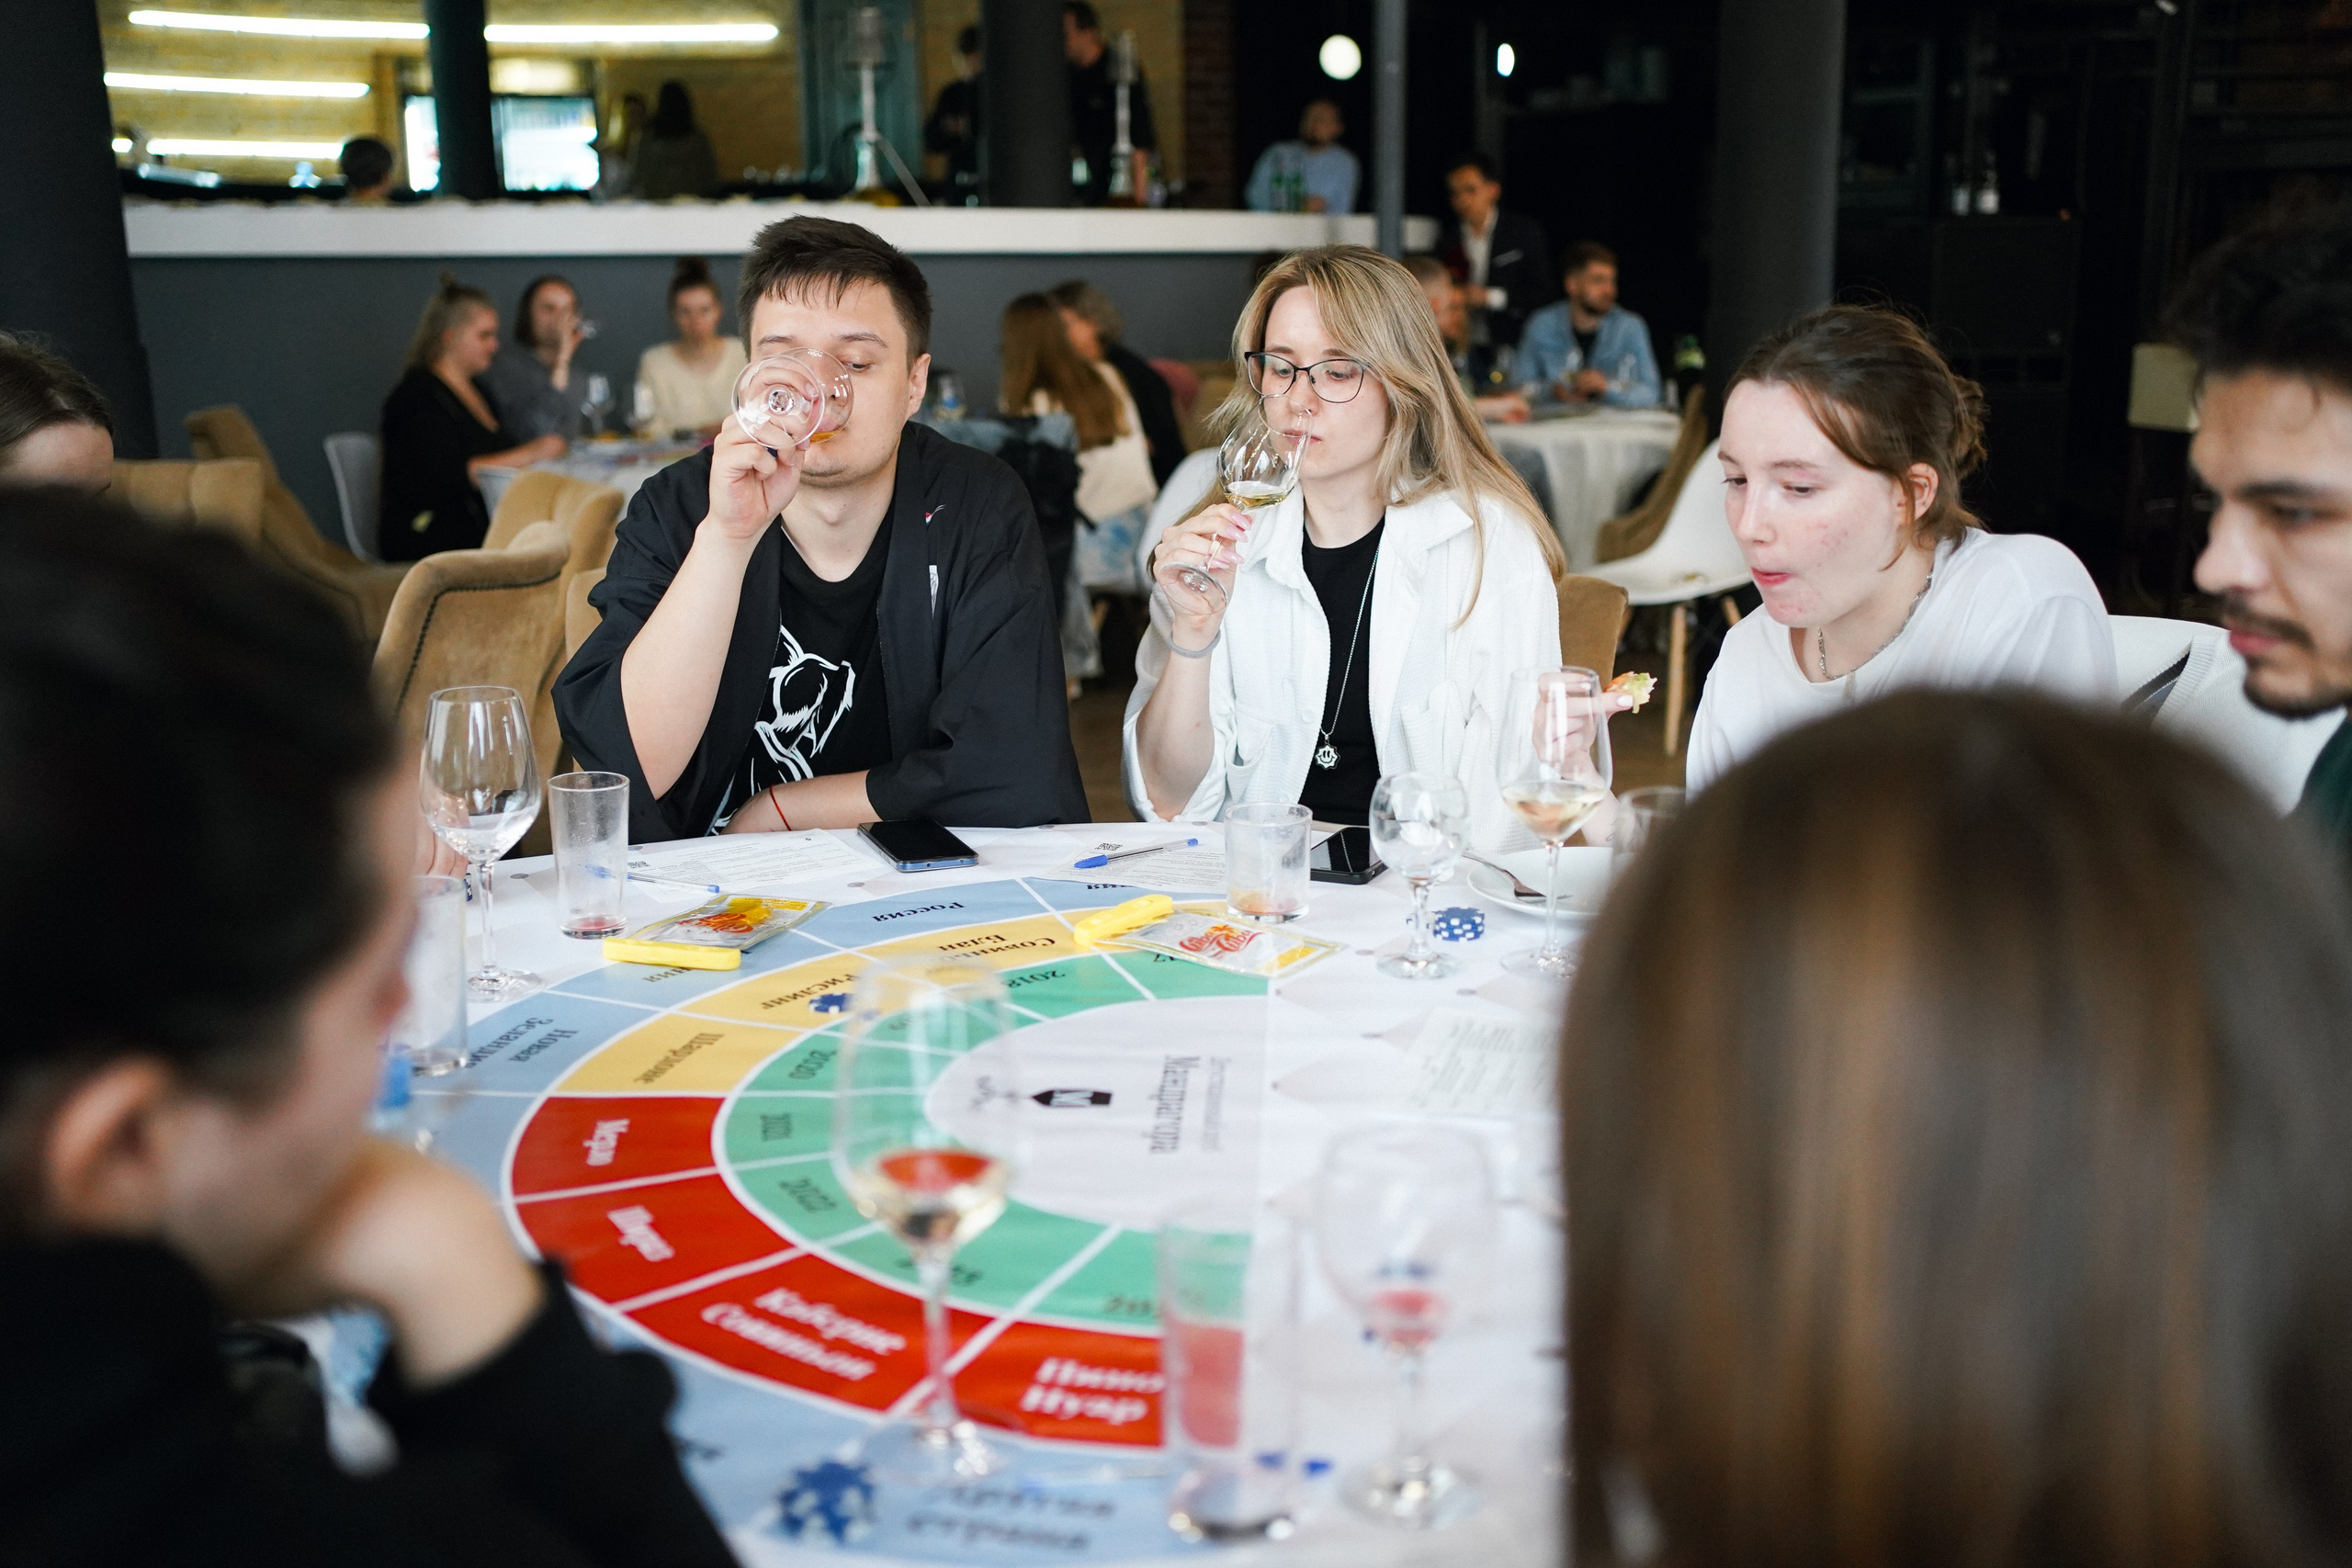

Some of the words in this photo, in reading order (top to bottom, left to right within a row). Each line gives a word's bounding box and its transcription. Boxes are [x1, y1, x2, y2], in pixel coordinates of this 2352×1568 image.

[872, 902, 966, 921] Россия
[937, 934, 1007, 951] Блан
[1004, 970, 1066, 987] 2018
[509, 1029, 579, 1062] Новая
[634, 1032, 725, 1084] Шардоне
[753, 1287, 909, 1355] Каберне
[1020, 1385, 1149, 1425] Нуар
